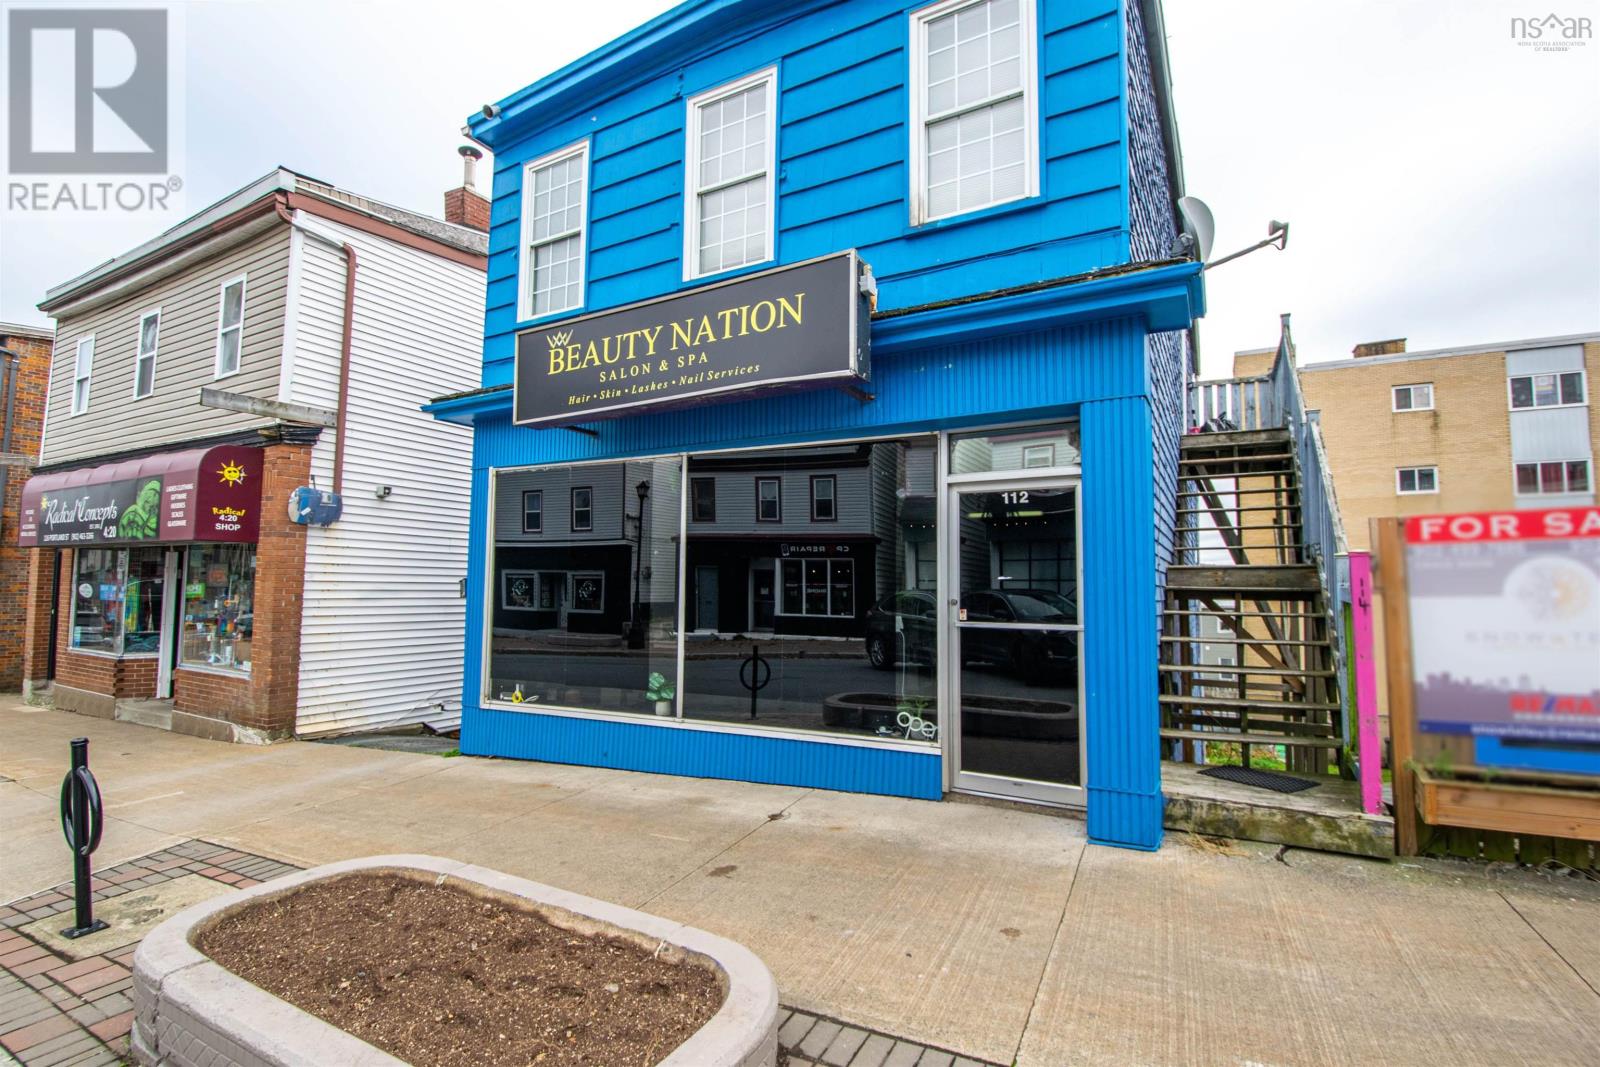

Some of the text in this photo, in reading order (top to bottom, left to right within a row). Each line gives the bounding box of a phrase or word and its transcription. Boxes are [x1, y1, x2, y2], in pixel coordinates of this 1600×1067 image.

[547, 293, 805, 375] BEAUTY NATION
[599, 353, 709, 383] SALON & SPA
[568, 362, 761, 406] Hair Skin Lashes Nail Services
[1001, 490, 1029, 505] 112
[45, 495, 118, 532] Radical Concepts
[212, 506, 246, 517] Radical
[219, 514, 238, 522] 4:20
[215, 522, 241, 531] SHOP
[1420, 514, 1520, 541] FOR
